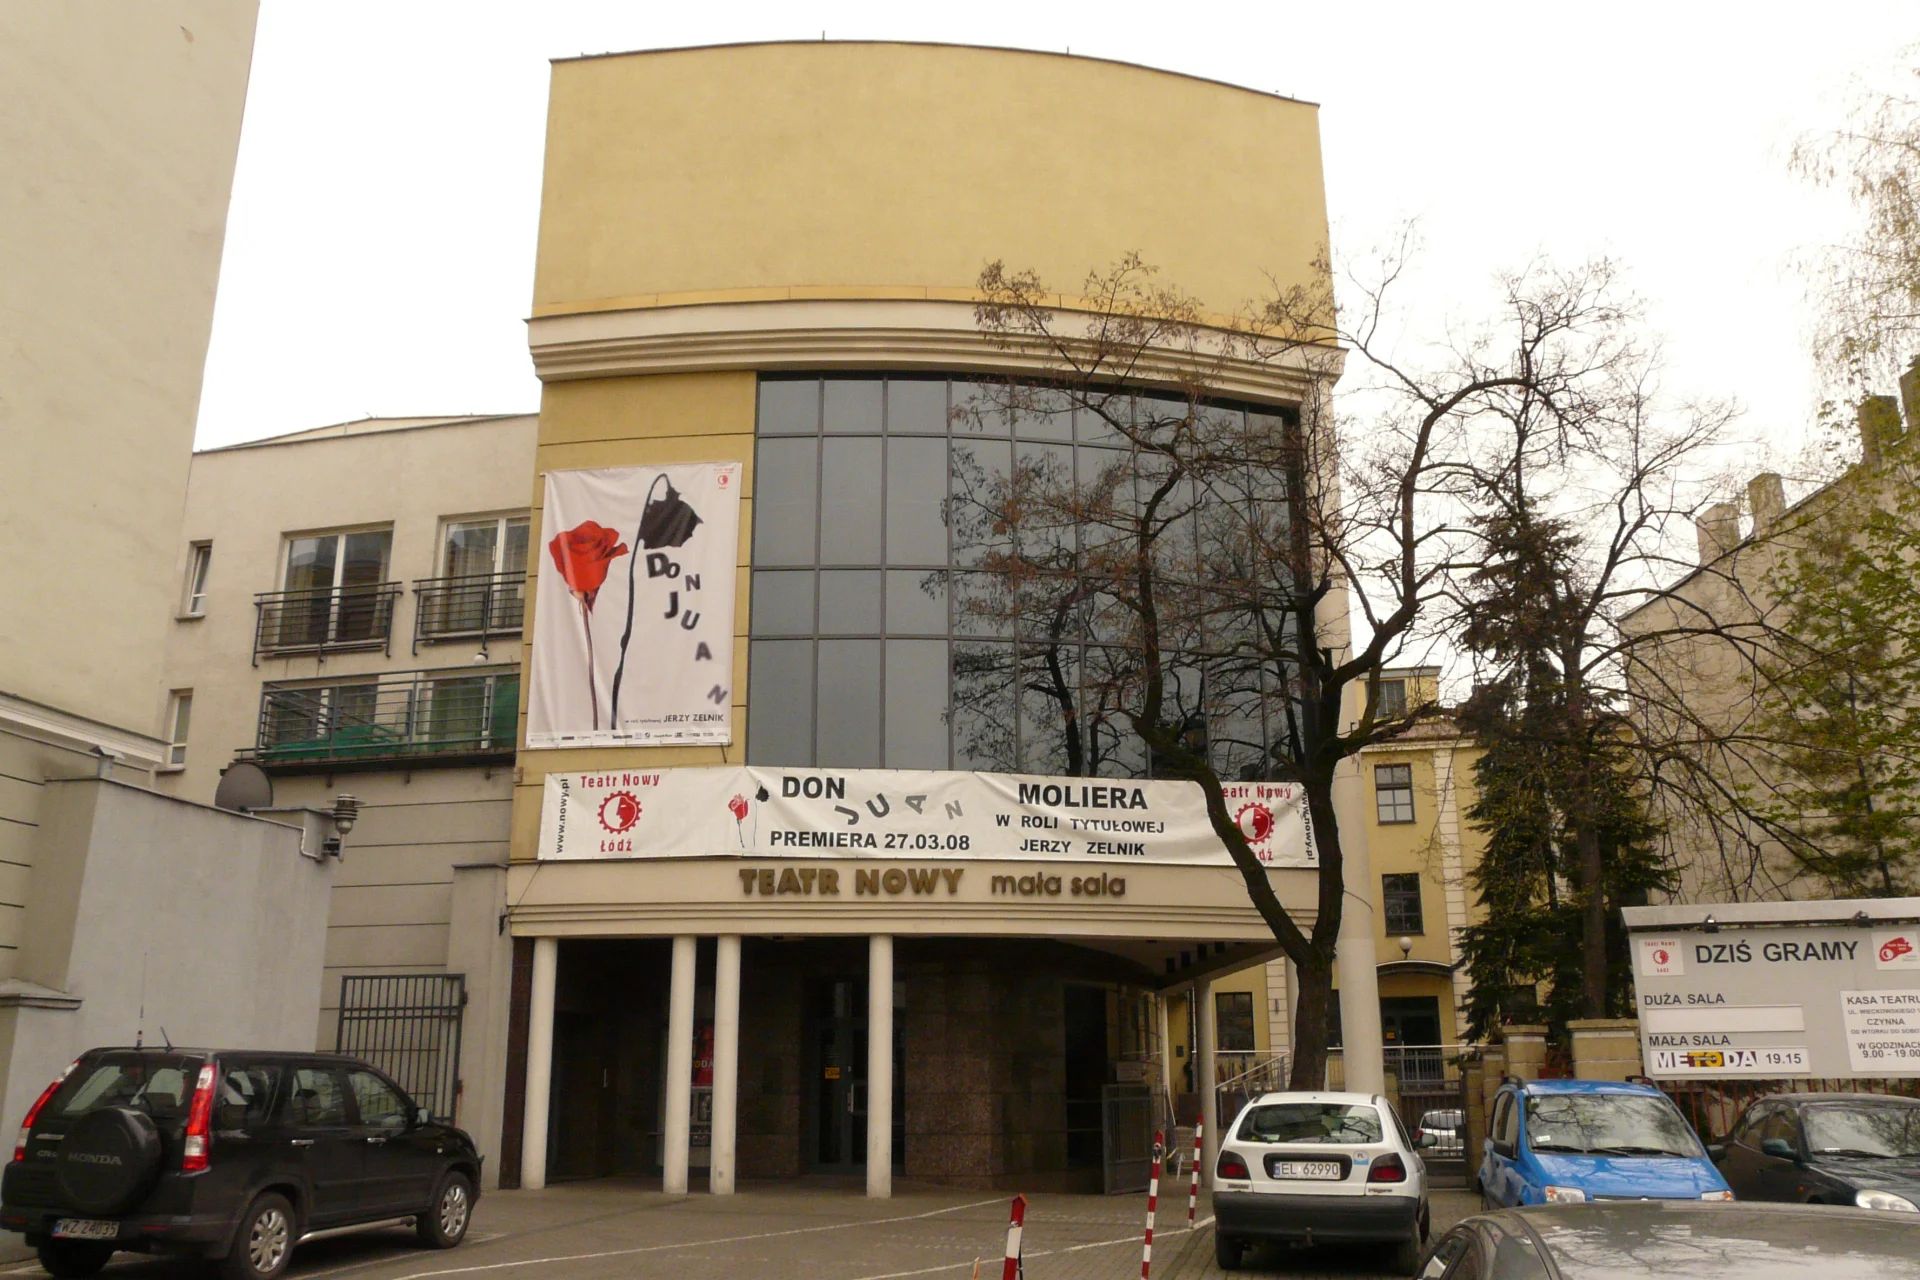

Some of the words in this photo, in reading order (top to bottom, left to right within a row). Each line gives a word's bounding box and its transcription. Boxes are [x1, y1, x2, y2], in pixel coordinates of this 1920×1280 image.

[646, 552, 700, 591] DON
[580, 774, 617, 789] Teatr
[622, 773, 660, 788] Nowy
[782, 776, 845, 800] DON
[1018, 783, 1148, 810] MOLIERA
[1221, 786, 1249, 798] eatr
[555, 778, 569, 854] www.nowy.pl
[995, 814, 1010, 827] W
[1021, 815, 1058, 829] ROLI
[1070, 818, 1165, 834] TYTUŁOWEJ
[600, 838, 633, 853] Łódź
[770, 831, 877, 849] PREMIERA
[884, 833, 970, 851] 27.03.08
[1019, 838, 1072, 854] JERZY
[1086, 841, 1145, 856] ZELNIK
[738, 868, 840, 896] TEATR
[855, 868, 964, 896] NOWY
[991, 871, 1062, 896] mała
[1071, 872, 1126, 897] sala
[1695, 940, 1752, 964] DZIŚ
[1763, 941, 1858, 963] GRAMY
[1644, 993, 1682, 1006] DUŻA
[1687, 993, 1725, 1005] SALA
[1847, 996, 1878, 1005] KASA
[1867, 1018, 1905, 1026] CZYNNA
[1648, 1035, 1689, 1048] MAŁA
[1692, 1034, 1731, 1047] SALA
[1766, 1053, 1802, 1065] 19.15
[1863, 1049, 1884, 1058] 9.00
[69, 1152, 122, 1166] HONDA
[1281, 1163, 1297, 1175] EL
[1303, 1163, 1339, 1176] 62990
